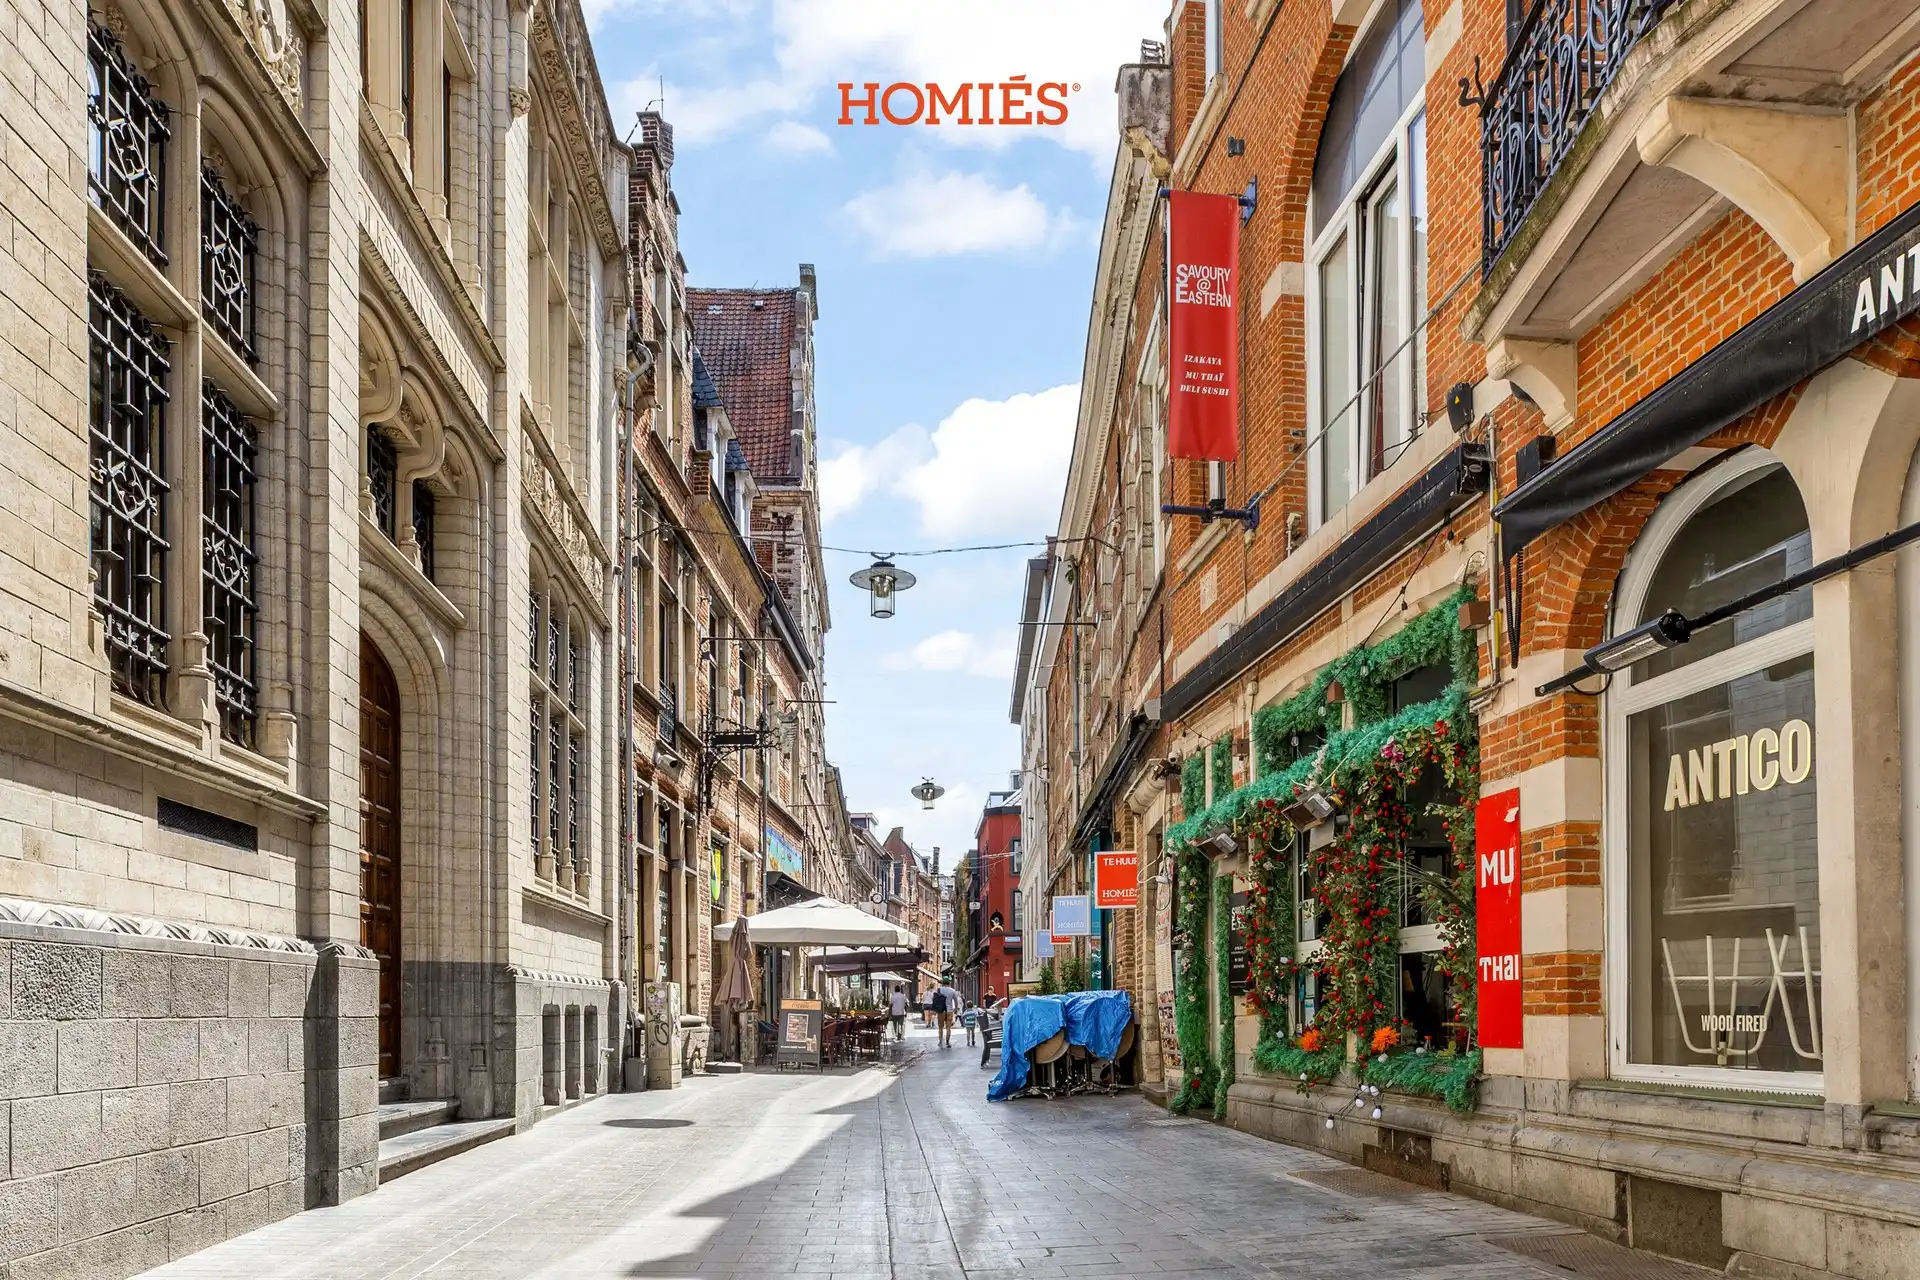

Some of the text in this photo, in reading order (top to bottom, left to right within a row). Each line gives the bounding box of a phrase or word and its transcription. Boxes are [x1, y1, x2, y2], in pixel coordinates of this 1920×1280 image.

[358, 187, 428, 327] OLKSBANK
[1176, 263, 1231, 284] SAVOURY
[1176, 283, 1231, 307] EASTERN
[1184, 354, 1222, 366] IZAKAYA
[1185, 371, 1199, 380] MU
[1180, 384, 1229, 397] DELI SUSHI
[1664, 719, 1812, 811] ANTICO
[1103, 858, 1115, 866] TE
[1481, 846, 1516, 888] MU
[1701, 1014, 1767, 1032] WOOD FIRED
